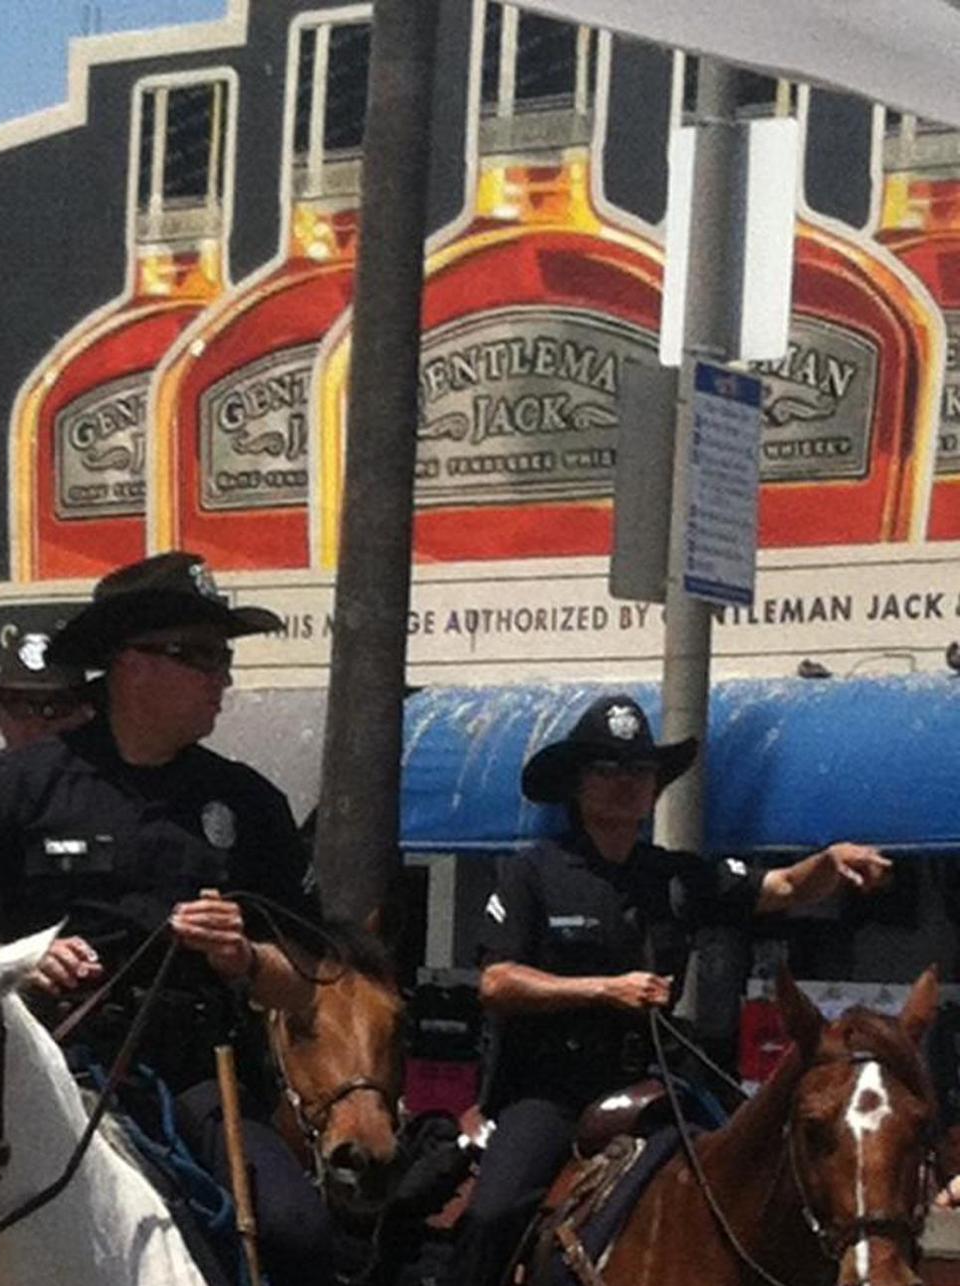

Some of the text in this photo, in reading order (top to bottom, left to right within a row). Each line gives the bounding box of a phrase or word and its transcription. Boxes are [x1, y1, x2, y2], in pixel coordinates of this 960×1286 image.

[469, 392, 571, 444] JACK
[444, 604, 607, 635] AUTHORIZED
[619, 601, 651, 630] BY
[866, 592, 944, 620] JACK
